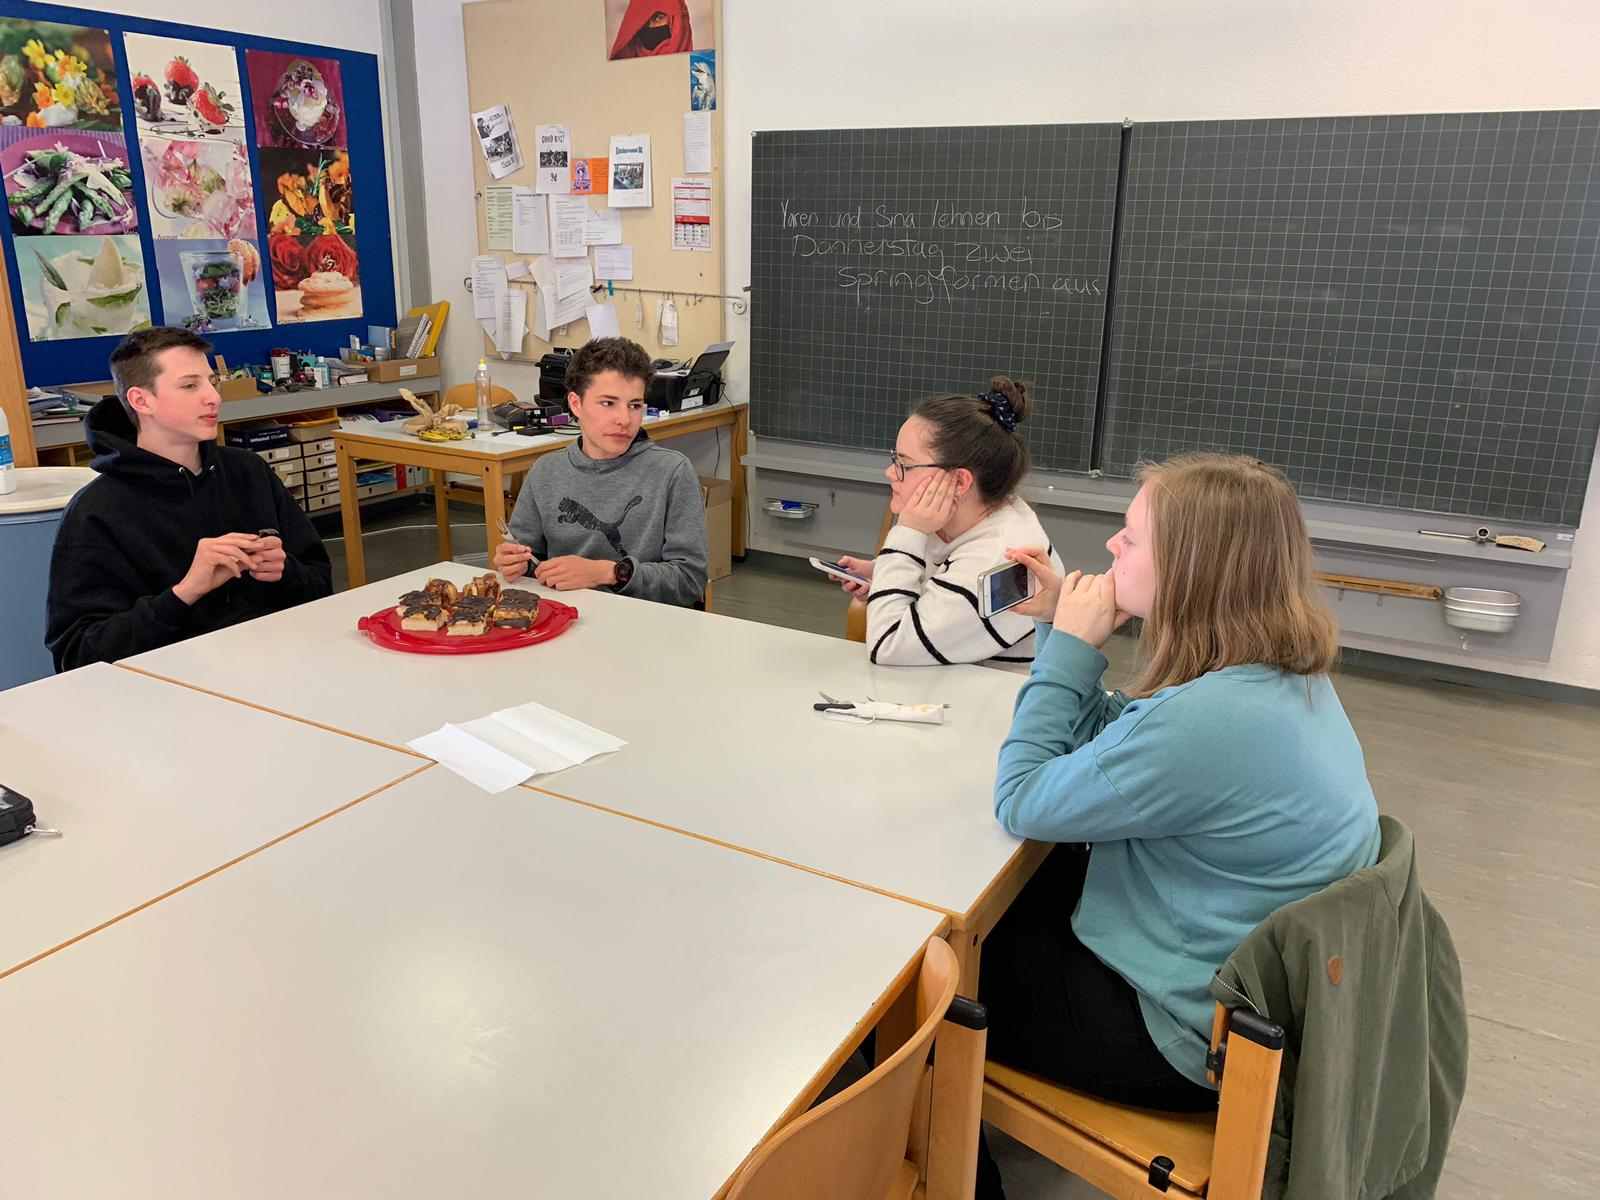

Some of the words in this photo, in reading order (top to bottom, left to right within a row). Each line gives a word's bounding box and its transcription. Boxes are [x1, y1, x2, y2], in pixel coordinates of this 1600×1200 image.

[829, 205, 861, 232] und
[1022, 195, 1063, 230] bis
[792, 234, 944, 276] Donnerstag
[1052, 277, 1102, 296] aus
